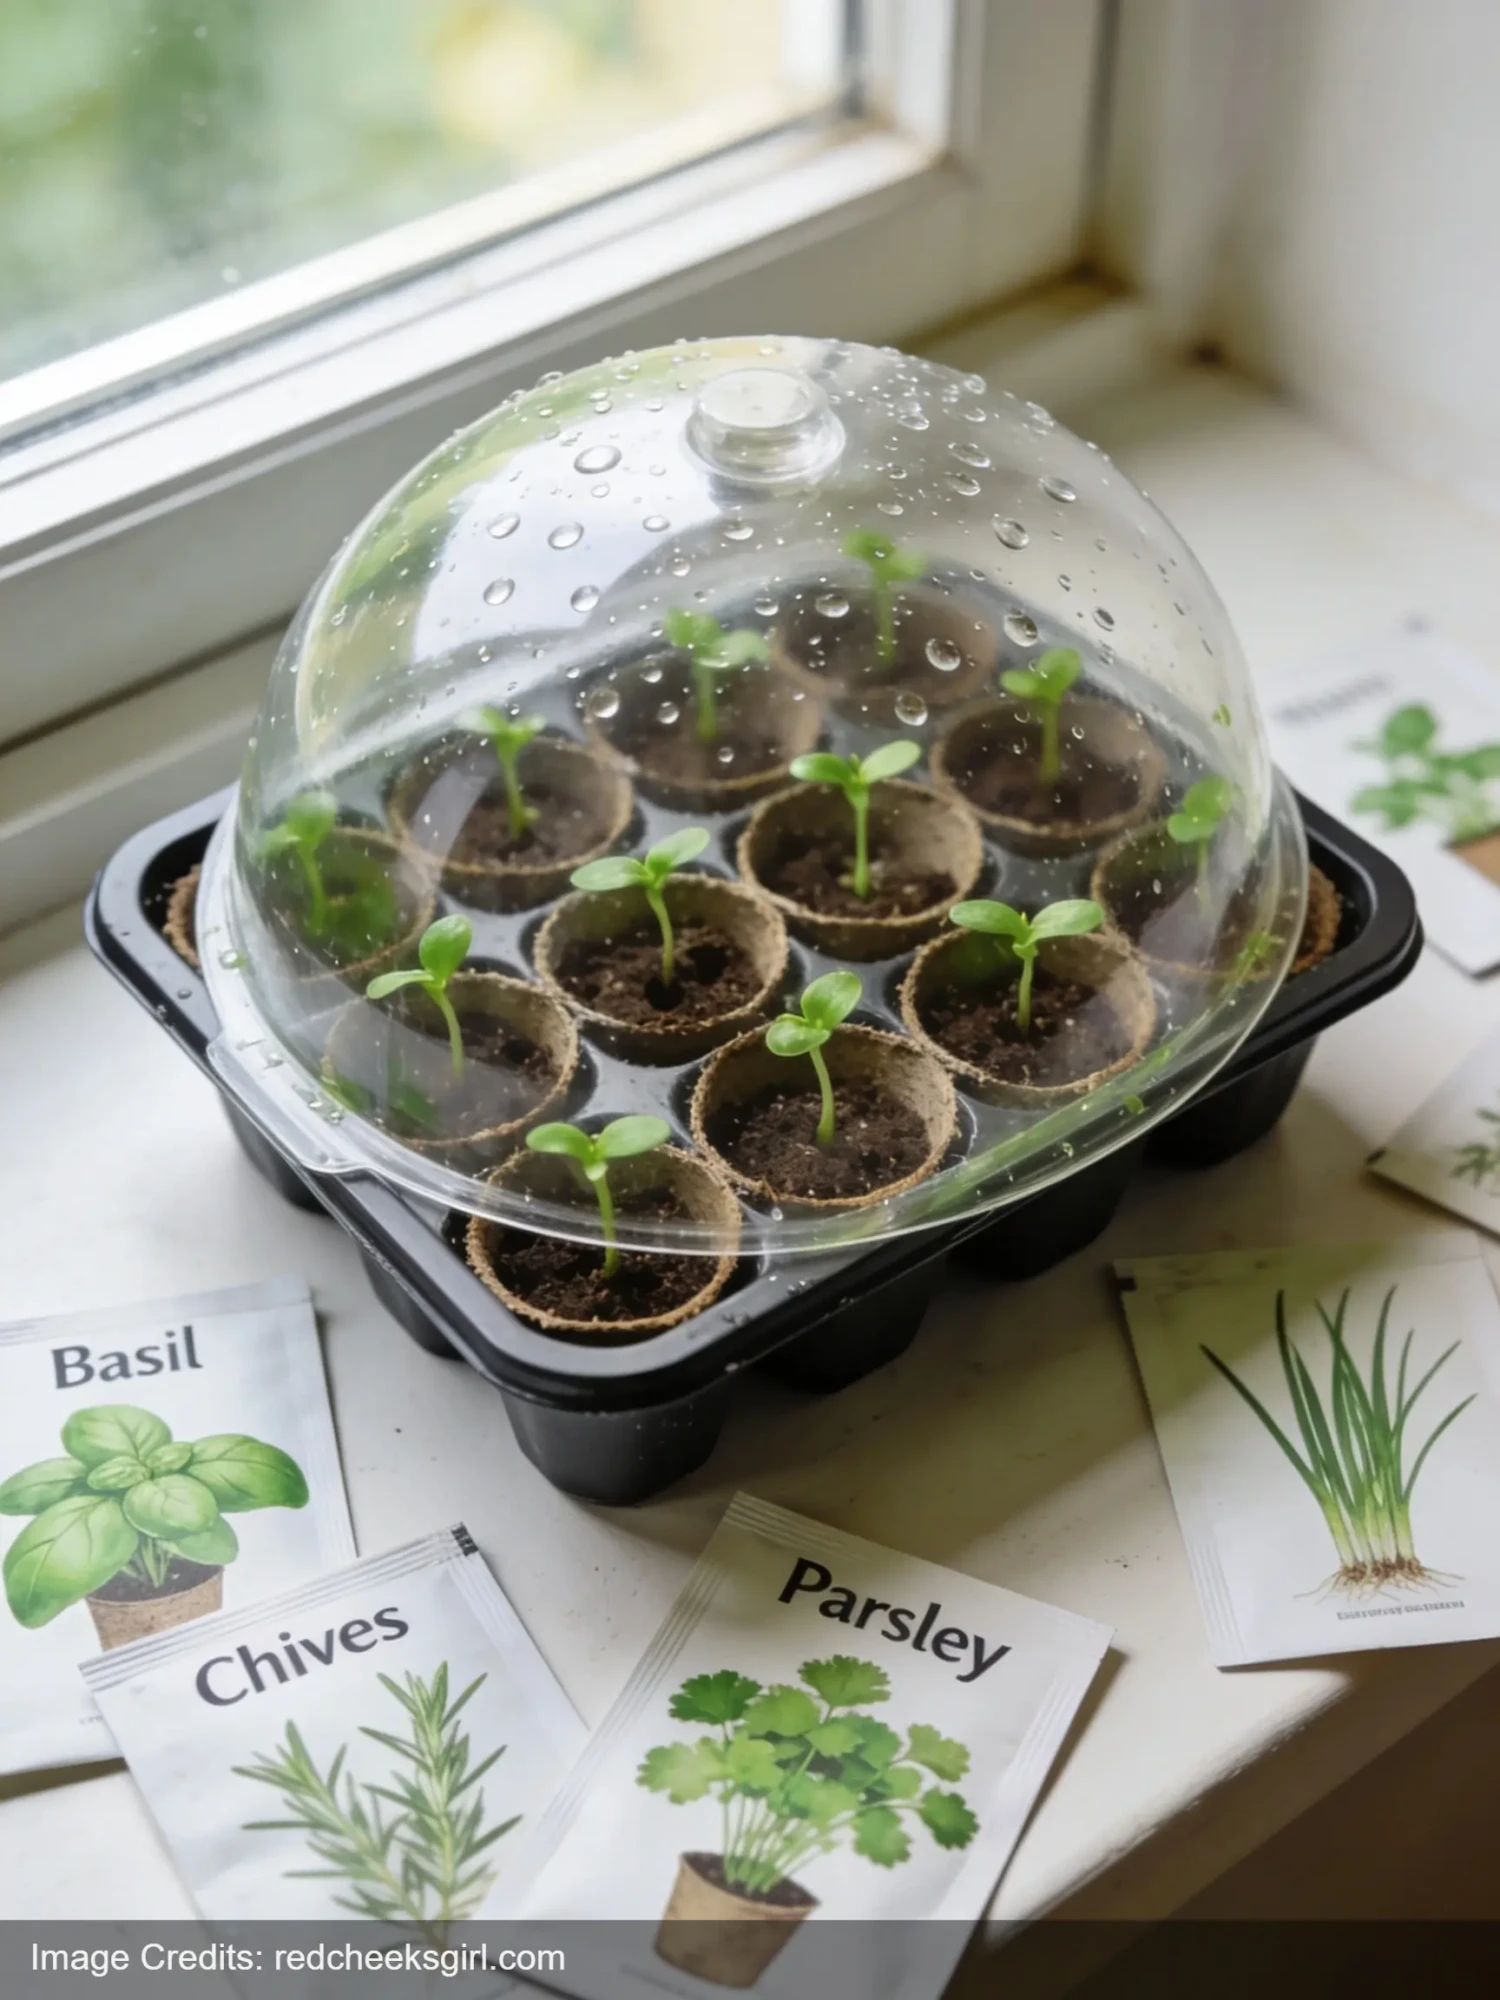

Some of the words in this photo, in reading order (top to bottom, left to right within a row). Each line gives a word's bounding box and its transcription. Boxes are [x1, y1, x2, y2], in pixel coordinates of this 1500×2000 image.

[51, 1325, 203, 1389] Basil
[195, 1606, 409, 1706] Chives
[777, 1557, 1012, 1683] Parsley
